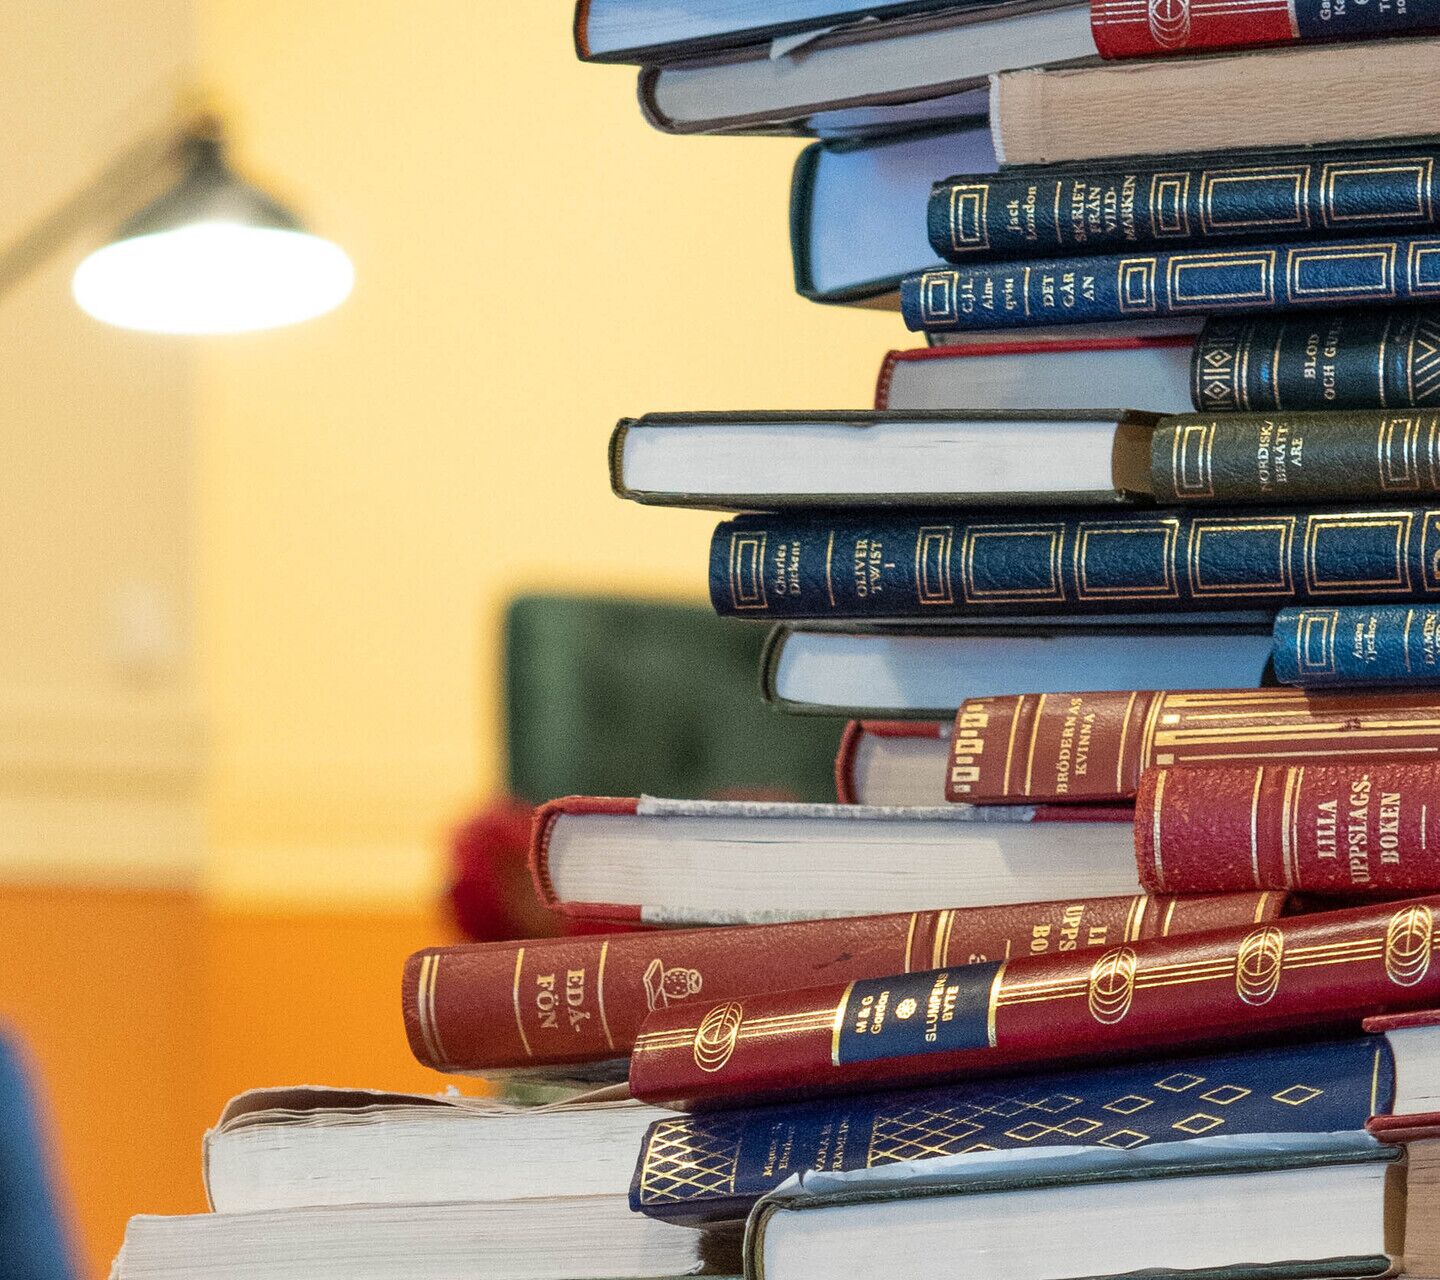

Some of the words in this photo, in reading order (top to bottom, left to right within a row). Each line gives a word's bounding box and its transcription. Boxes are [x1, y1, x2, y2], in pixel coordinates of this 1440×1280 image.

[1086, 186, 1102, 234] FRÅN
[1042, 274, 1055, 308] DET
[1060, 272, 1075, 308] GÅR
[1082, 276, 1095, 301] AN
[1323, 365, 1336, 400] OCH
[1291, 437, 1304, 467] ARE
[774, 543, 787, 595] Charles
[787, 540, 802, 595] Dickens
[854, 538, 868, 598] OLIVER
[869, 540, 883, 594] TWIST
[1055, 698, 1083, 795] BRÖDERNAS
[1075, 713, 1096, 776] KVINNA
[1316, 799, 1338, 859] LILLA
[1348, 774, 1372, 884] UPPSLAGS-
[1379, 792, 1401, 865] BOKEN
[1029, 923, 1053, 956] BO
[536, 973, 559, 1029] FÖN
[566, 967, 591, 1033] EDÅ-
[861, 995, 874, 1006] G
[870, 990, 891, 1035] Gordon
[925, 972, 950, 1043] SLUMPENS
[941, 985, 960, 1022] BYTE
[855, 1021, 868, 1034] M
